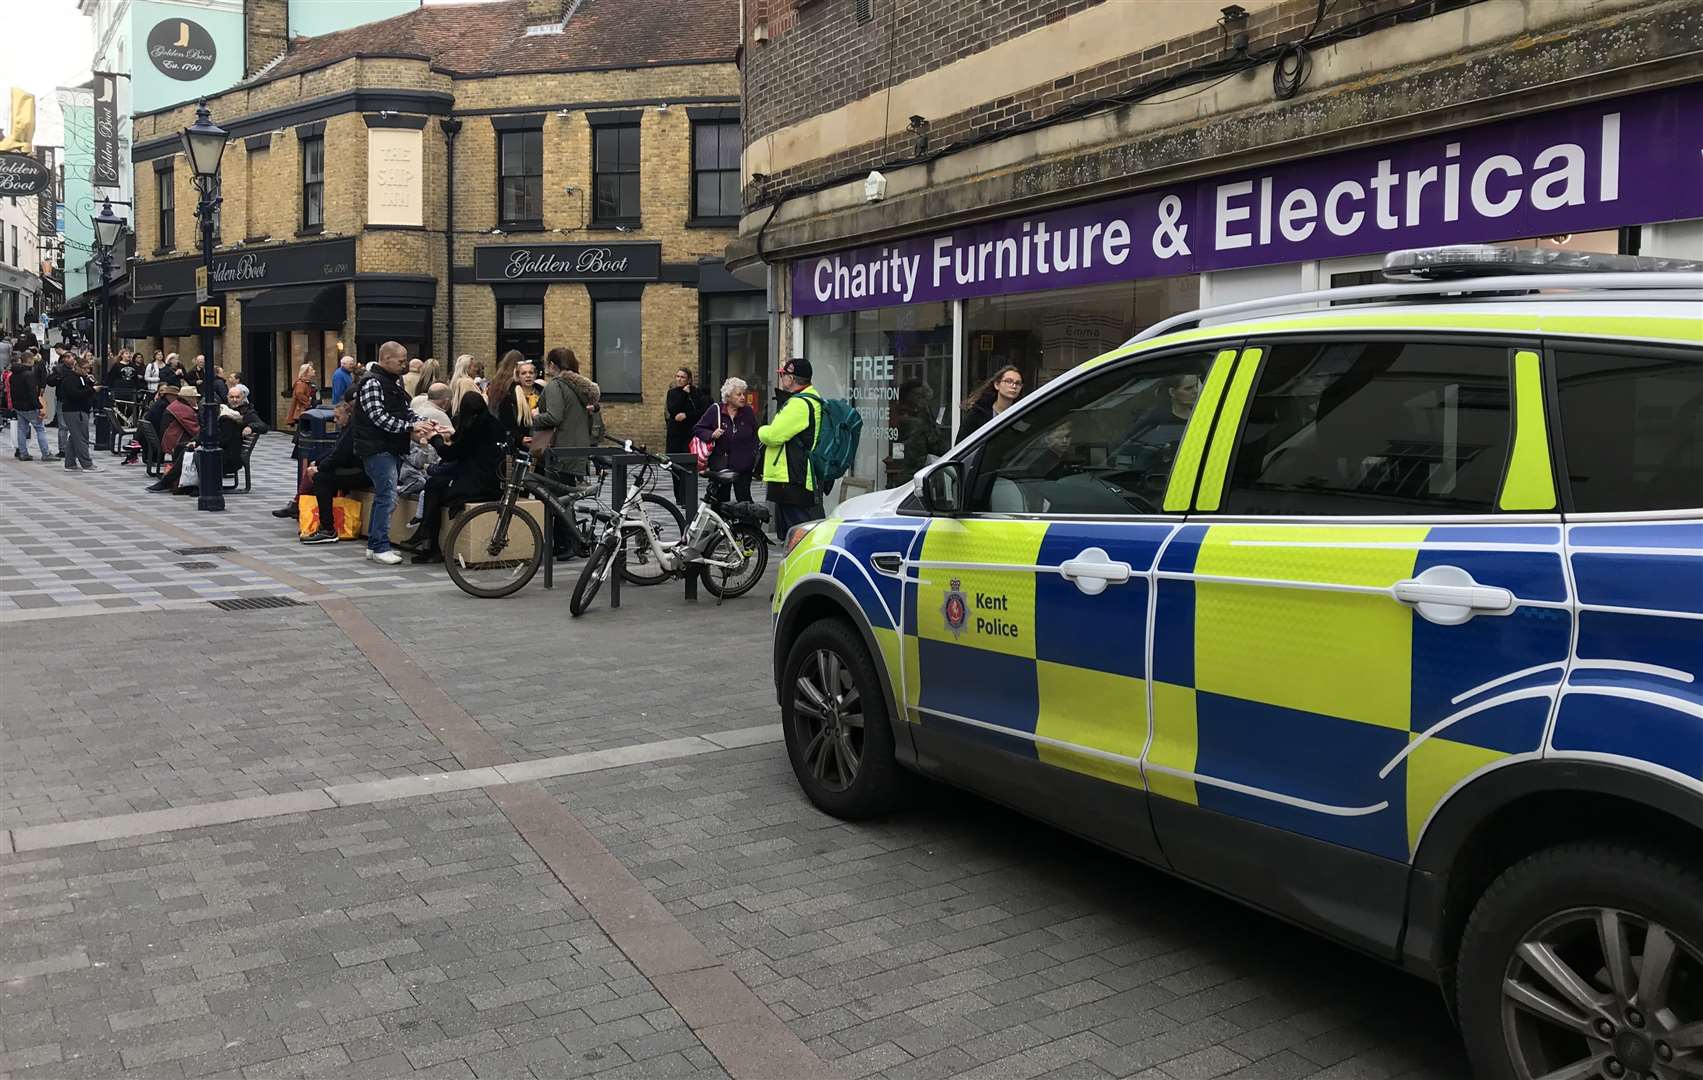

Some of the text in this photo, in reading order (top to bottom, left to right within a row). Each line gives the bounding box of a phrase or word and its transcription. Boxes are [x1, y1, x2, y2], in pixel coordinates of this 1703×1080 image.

[150, 44, 213, 61] Golden Boot
[181, 63, 202, 71] 1790
[97, 106, 117, 181] Golden Boot
[813, 111, 1622, 304] Charity Furniture & Electrical
[236, 253, 266, 280] Boot
[504, 247, 629, 279] Golden Boot
[853, 355, 895, 380] FREE
[848, 386, 900, 400] COLLECTION
[856, 406, 890, 420] SERVICE
[976, 592, 1008, 611] Kent
[976, 618, 1019, 637] Police
